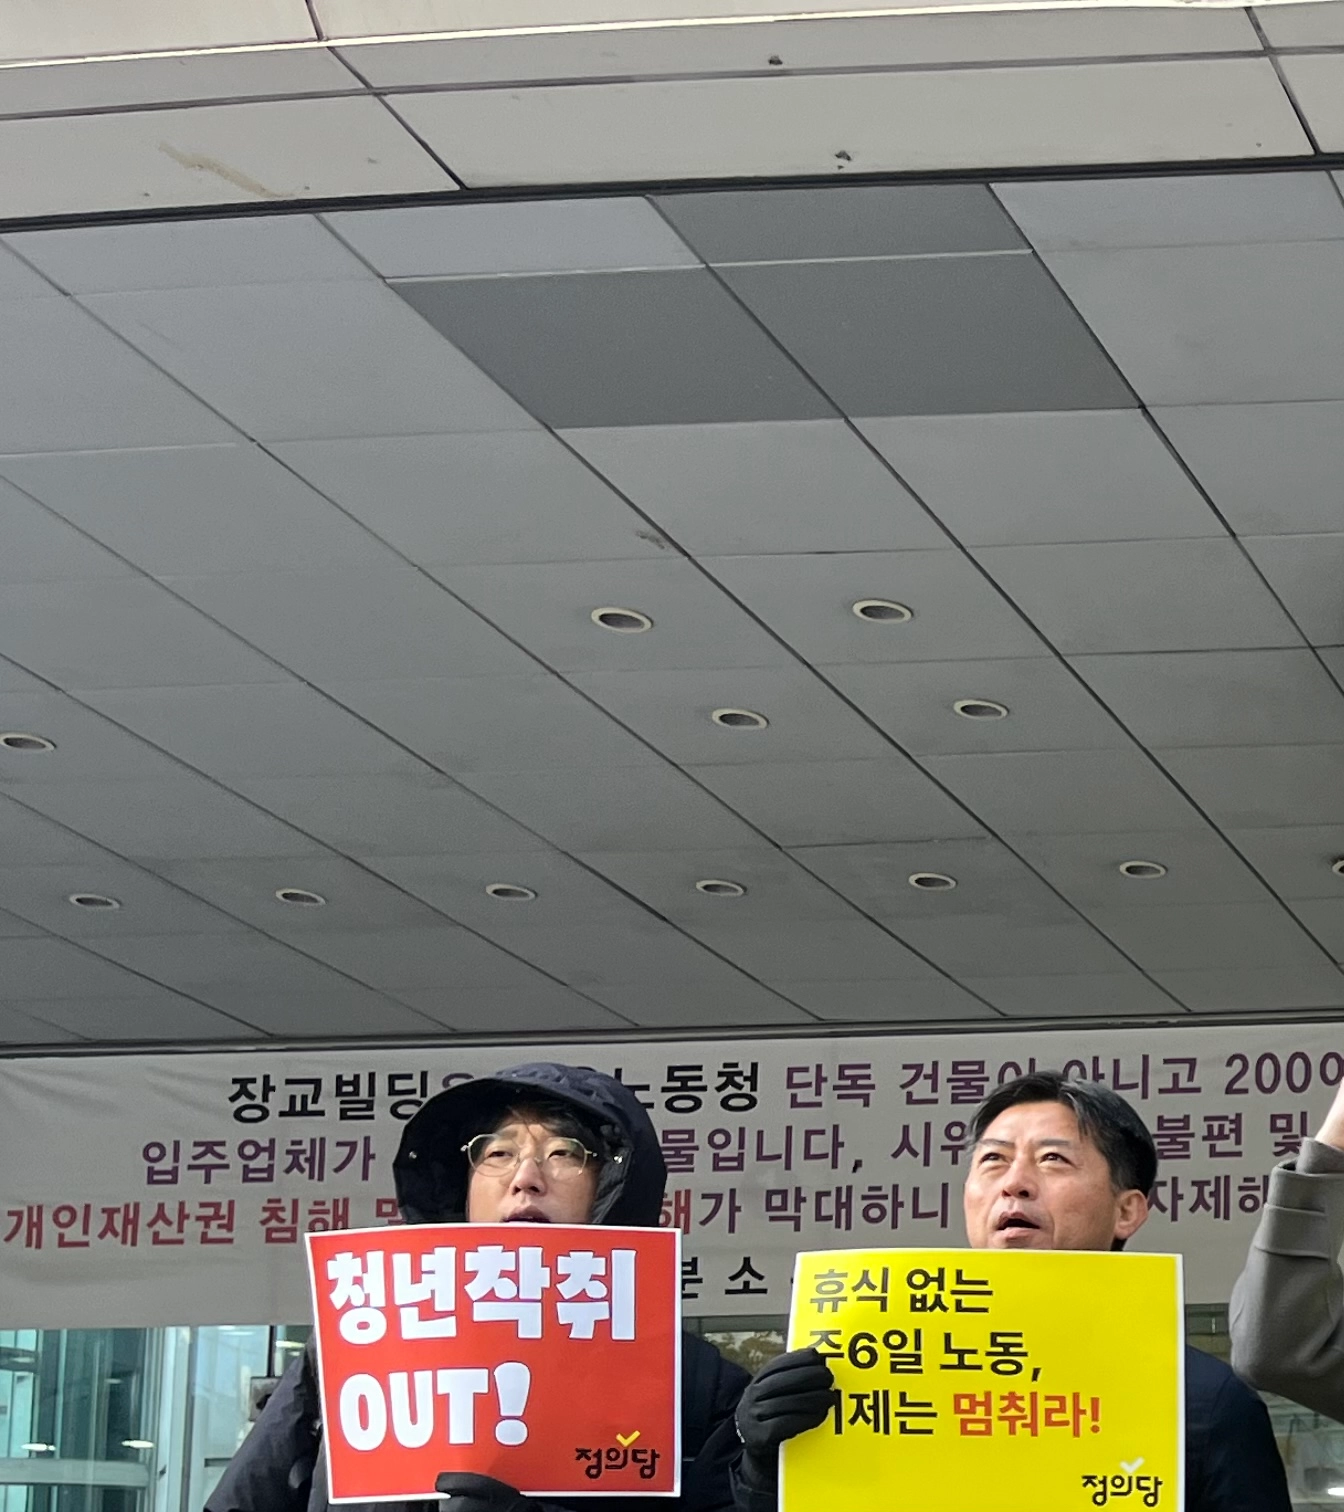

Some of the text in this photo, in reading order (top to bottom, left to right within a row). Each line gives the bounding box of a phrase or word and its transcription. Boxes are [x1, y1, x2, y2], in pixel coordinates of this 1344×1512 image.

[228, 1070, 474, 1123] 장교빌딩
[786, 1063, 876, 1108] 단독
[142, 1136, 376, 1185] 입주업체가
[1152, 1112, 1244, 1160] 불편
[3, 1202, 235, 1250] 개인재산권
[260, 1197, 350, 1243] 침해
[765, 1182, 949, 1232] 막대하니
[326, 1244, 638, 1345] 청년착취
[807, 1266, 994, 1314] 휴식 없는
[939, 1331, 1042, 1382] 노동,
[339, 1360, 532, 1452] OUT!
[952, 1390, 1101, 1438] 멈춰라!
[575, 1446, 661, 1480] 정의당
[1081, 1474, 1163, 1508] 정의당
